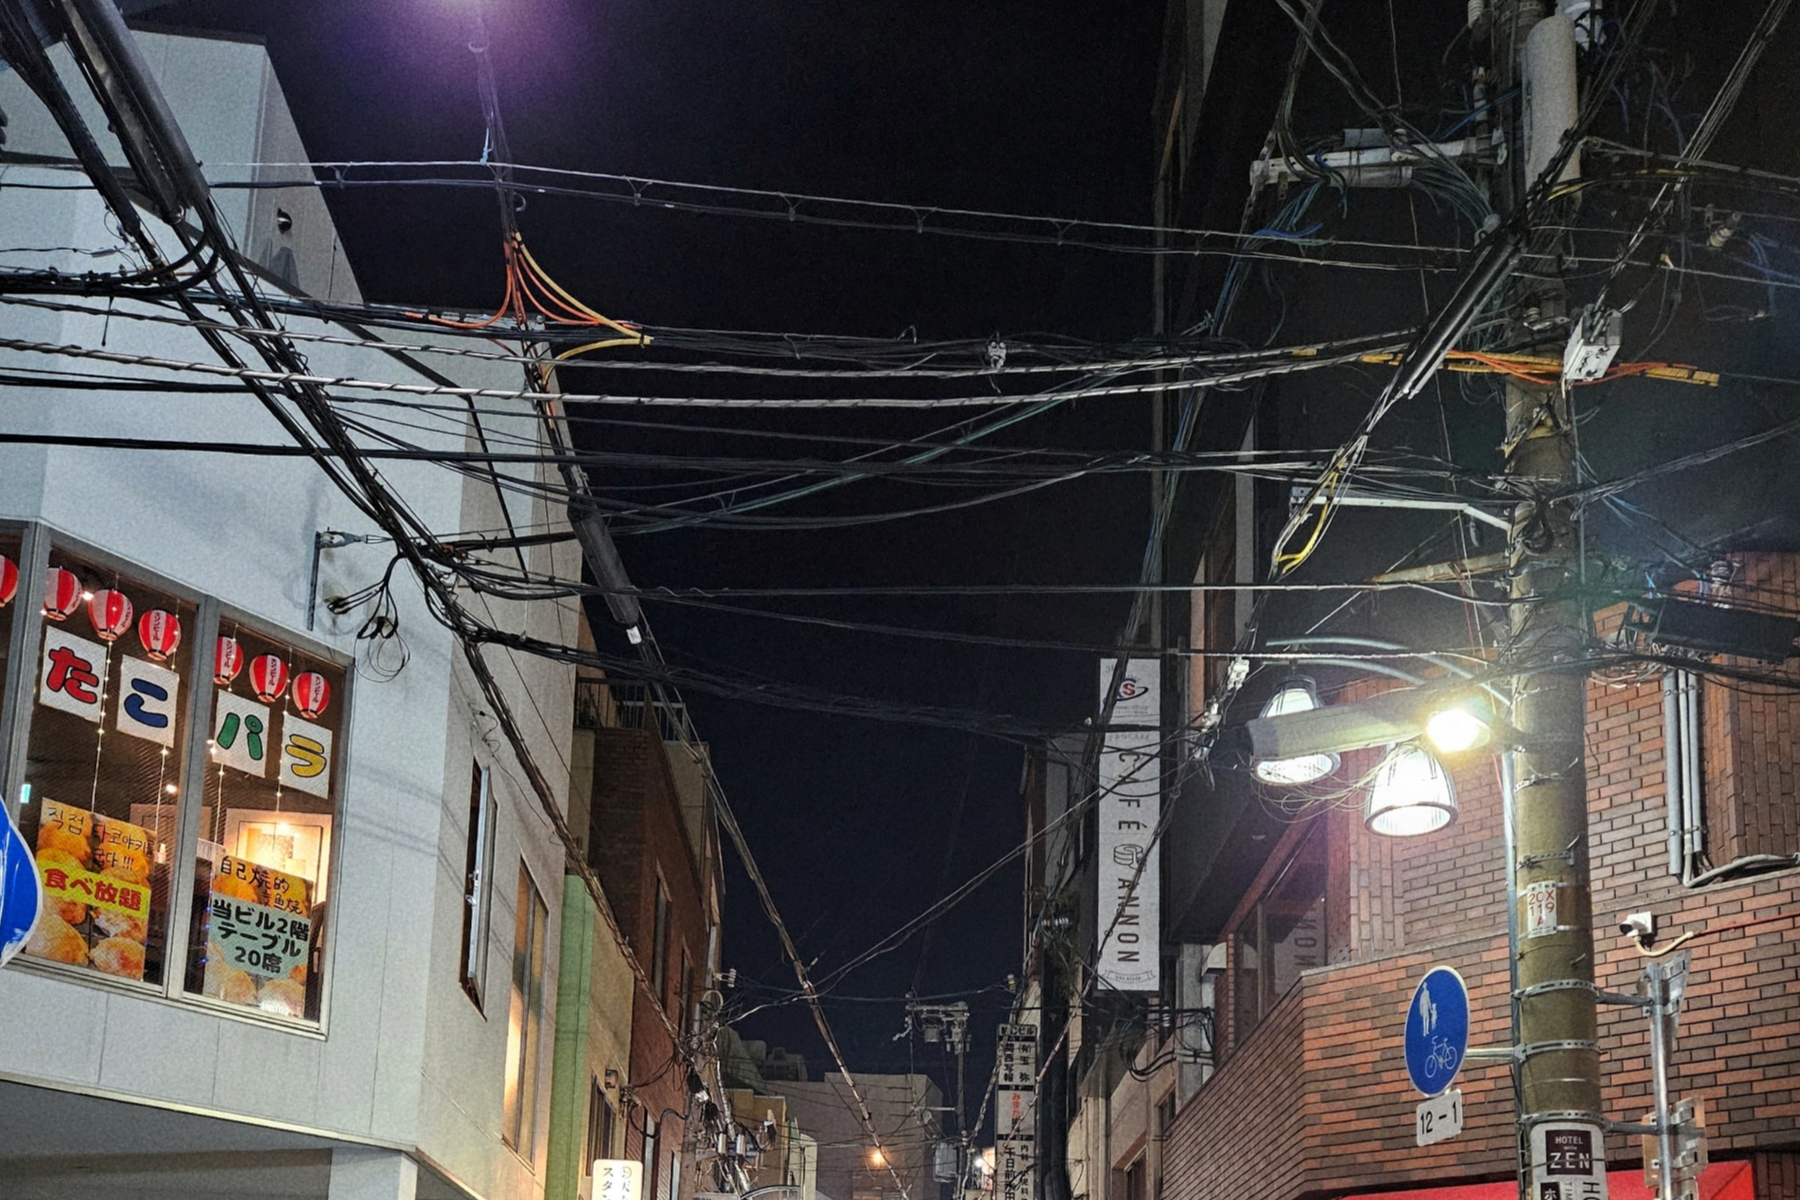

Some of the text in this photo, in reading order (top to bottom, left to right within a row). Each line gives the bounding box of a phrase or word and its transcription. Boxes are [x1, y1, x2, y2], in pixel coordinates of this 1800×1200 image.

[44, 868, 142, 912] 食べ放題
[212, 898, 310, 942] 当ビル2階
[1117, 877, 1140, 962] ANNON
[1529, 901, 1555, 917] 119
[217, 920, 302, 957] テーブル
[234, 946, 283, 973] 20席
[1420, 1102, 1457, 1135] 12-1
[1555, 1136, 1583, 1144] HOTEL
[1550, 1153, 1590, 1169] ZEN
